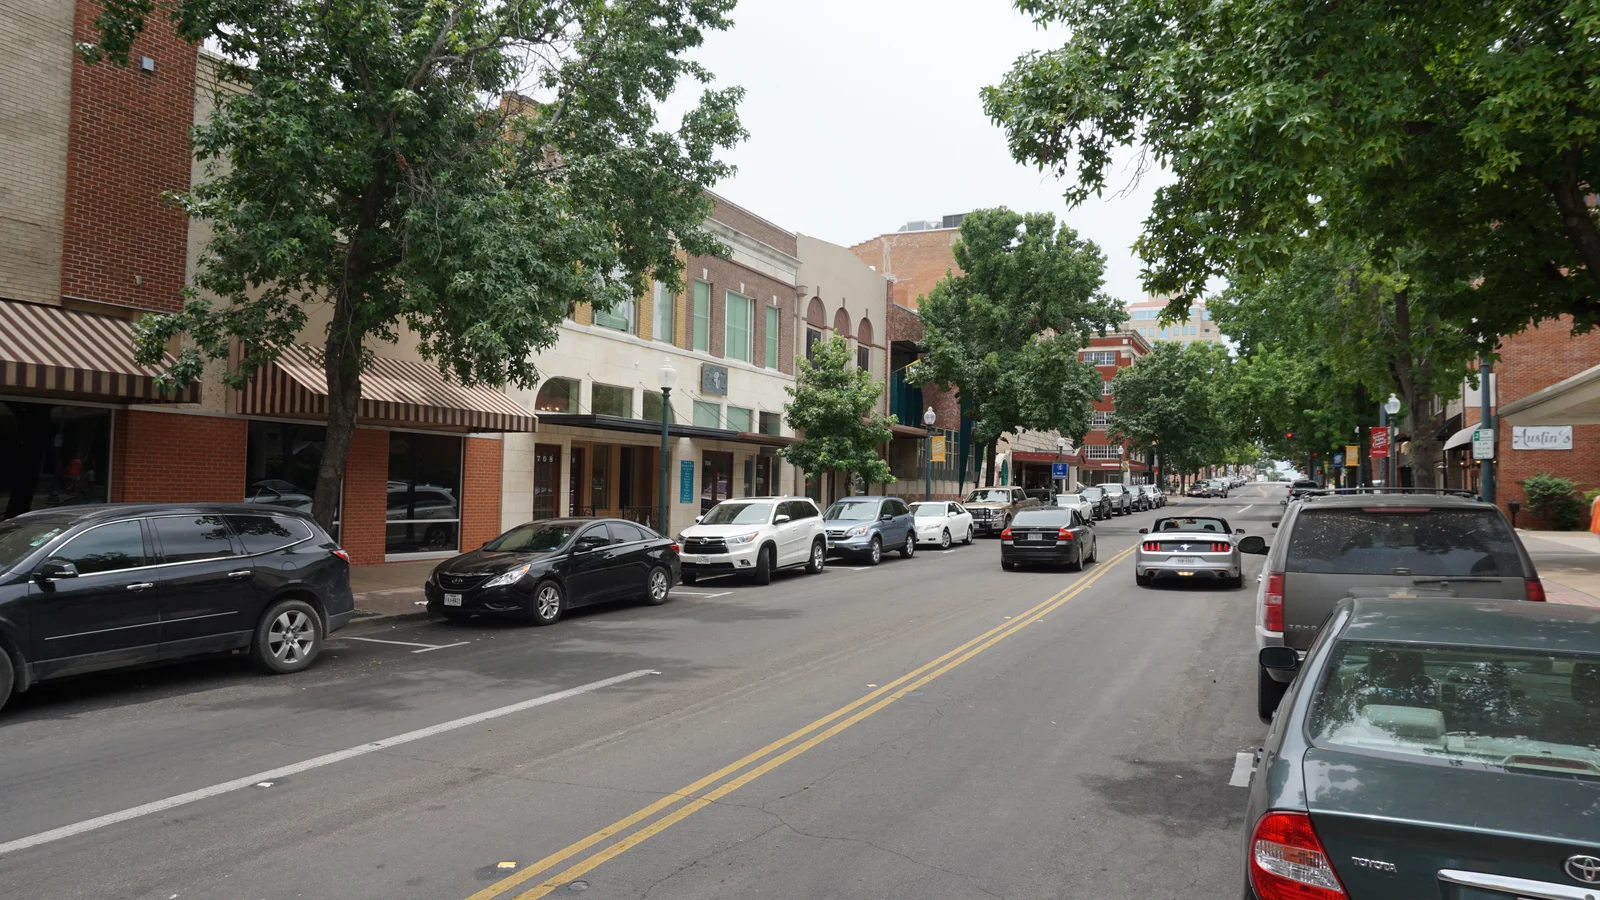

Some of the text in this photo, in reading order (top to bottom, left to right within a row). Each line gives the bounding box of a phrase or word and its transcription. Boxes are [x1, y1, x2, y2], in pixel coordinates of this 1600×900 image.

[1513, 428, 1571, 448] Austin's
[536, 455, 554, 463] 708
[1351, 856, 1398, 873] TOYOTA
